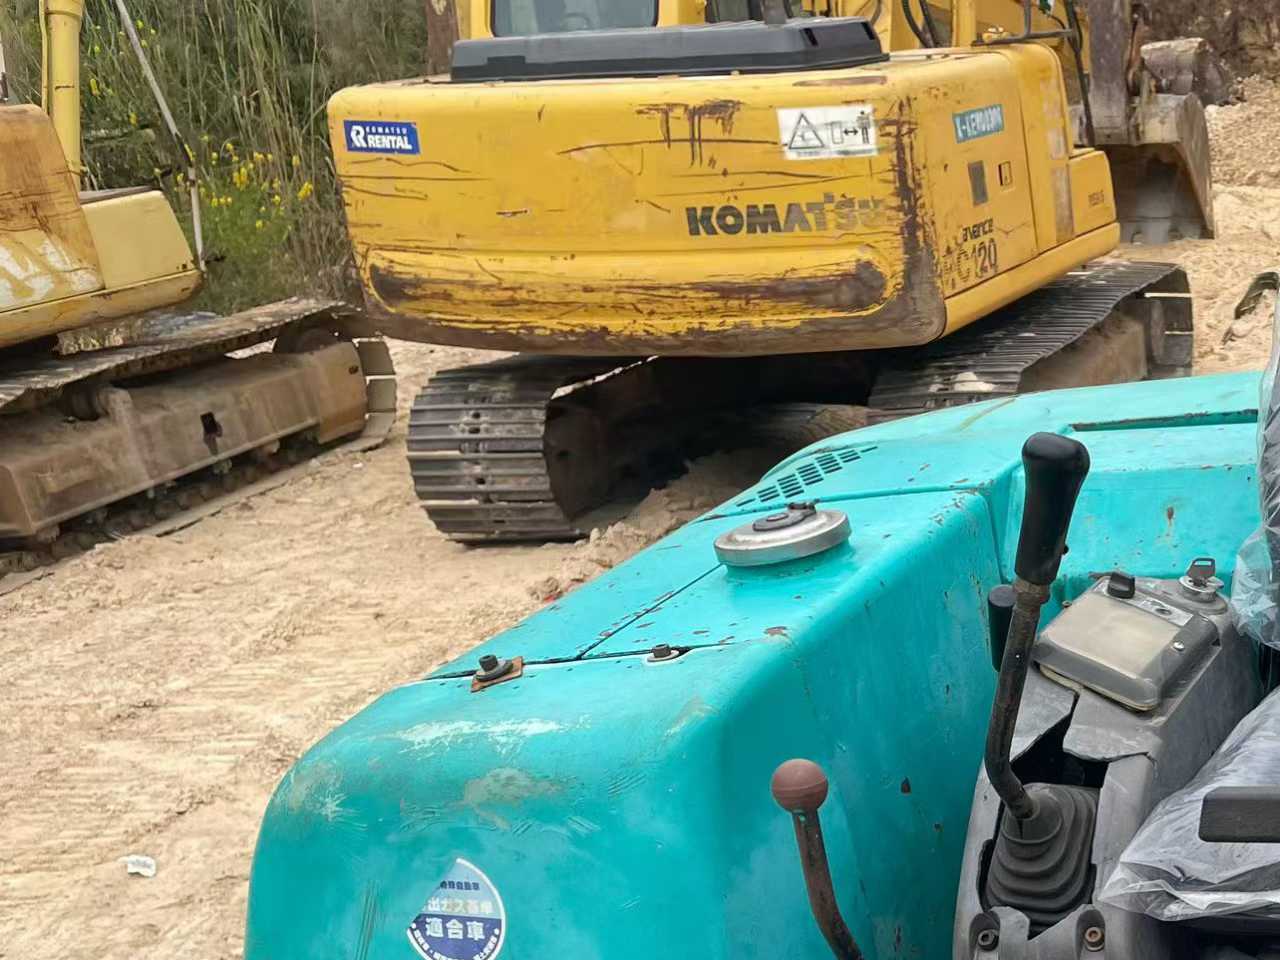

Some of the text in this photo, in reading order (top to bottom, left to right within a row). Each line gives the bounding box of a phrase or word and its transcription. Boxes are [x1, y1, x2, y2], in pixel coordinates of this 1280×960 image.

[367, 135, 412, 150] RENTAL
[426, 917, 486, 941] 適合車
